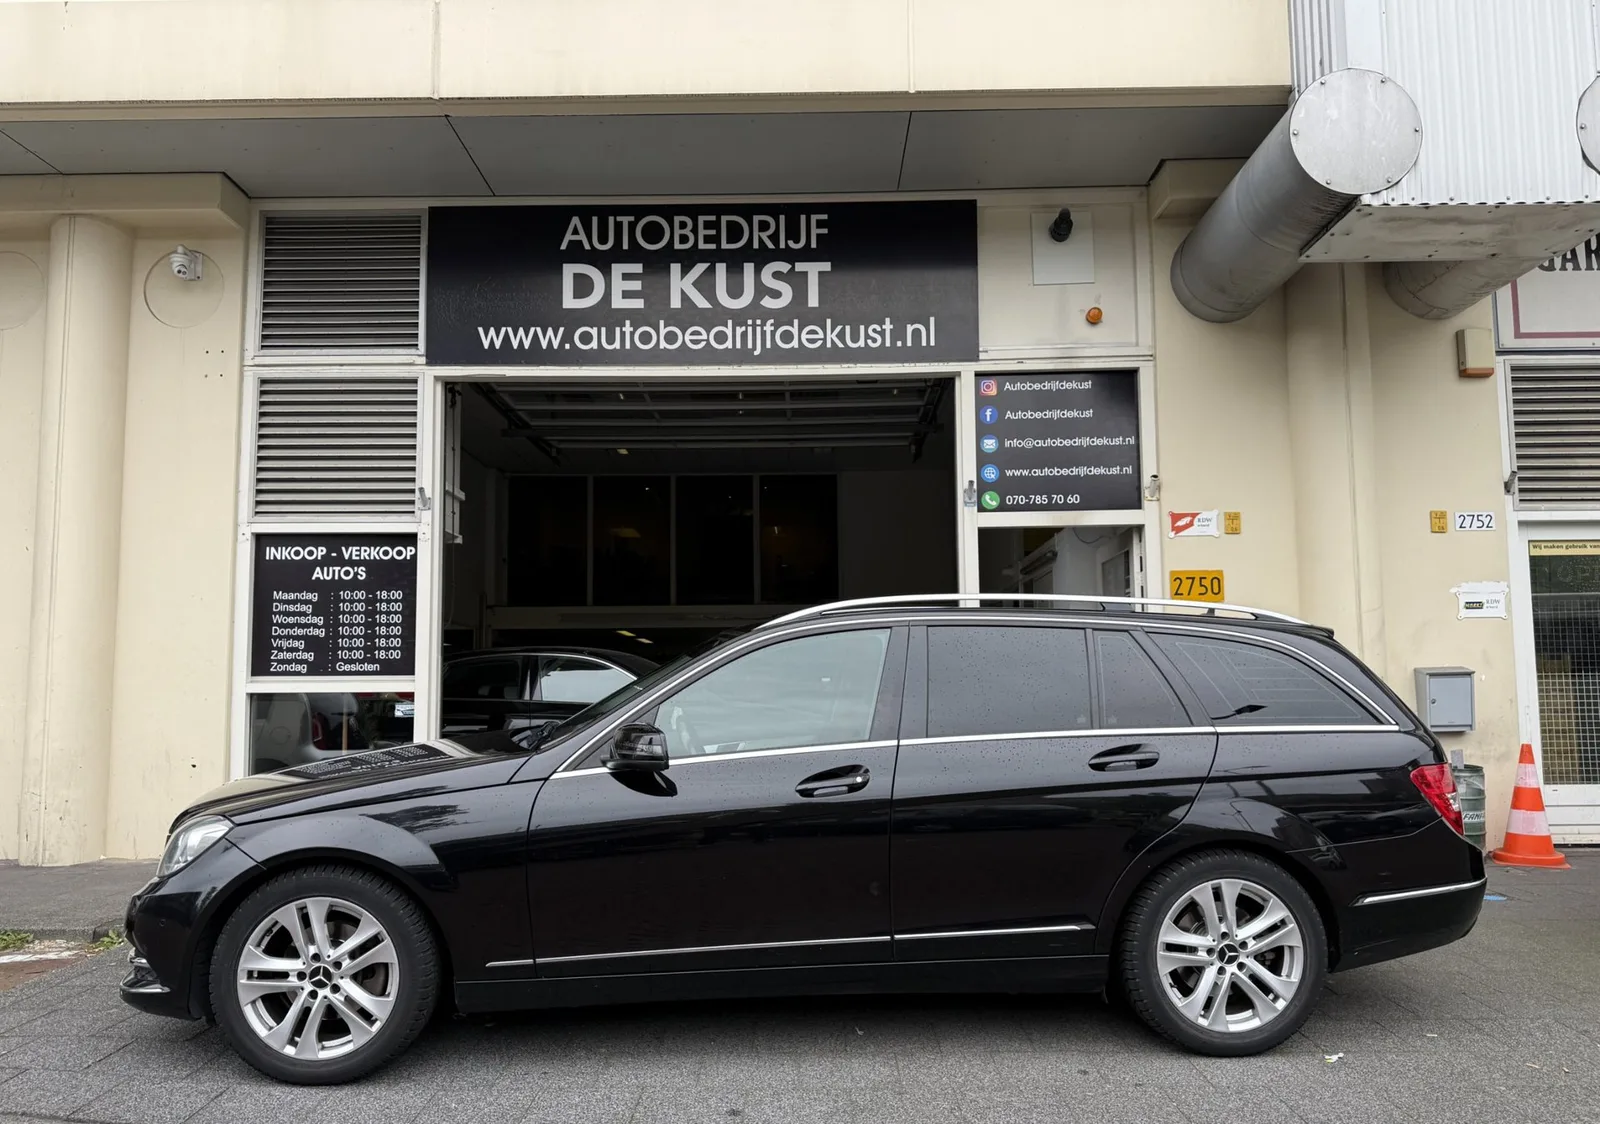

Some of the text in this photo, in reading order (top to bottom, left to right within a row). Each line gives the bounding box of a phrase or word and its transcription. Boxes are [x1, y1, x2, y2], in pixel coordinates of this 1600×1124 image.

[560, 214, 828, 251] AUTOBEDRIJF
[1537, 232, 1600, 272] AR
[562, 261, 832, 309] DE KUST
[478, 316, 936, 356] www.autobedrijfdekust.nl
[1003, 379, 1092, 392] Autobedrijfdekust
[1004, 408, 1093, 420] Autobedrijfdekust
[1004, 435, 1135, 449] info@autobedrijfdekust.nl
[1004, 464, 1133, 478] www.autobedrijfdekust.nl
[1005, 493, 1081, 505] 070-785 70 60
[1458, 514, 1493, 529] 2752
[265, 546, 327, 560] INKOOP
[341, 546, 416, 560] VERKOOP
[311, 566, 367, 580] AUTO'S
[1173, 576, 1222, 596] 2750
[273, 591, 318, 602] Maandag
[339, 591, 366, 600] 10:00
[375, 591, 403, 600] 18:00
[272, 603, 313, 614] Dinsdag
[339, 603, 366, 612] 10:00
[375, 603, 403, 612] 18:00
[272, 615, 324, 626] Woensdag
[339, 614, 366, 624] 10:00
[375, 614, 403, 624] 18:00
[271, 626, 325, 638] Donderdag
[338, 626, 365, 636] 10:00
[374, 626, 402, 636] 18:00
[271, 638, 305, 650] Vrijdag
[338, 638, 365, 648] 10:00
[374, 638, 402, 648] 18:00
[270, 650, 315, 661] Zaterdag
[338, 650, 365, 660] 10:00
[374, 650, 402, 660] 18:00
[269, 662, 308, 674] Zondag
[335, 661, 380, 672] Gesloten
